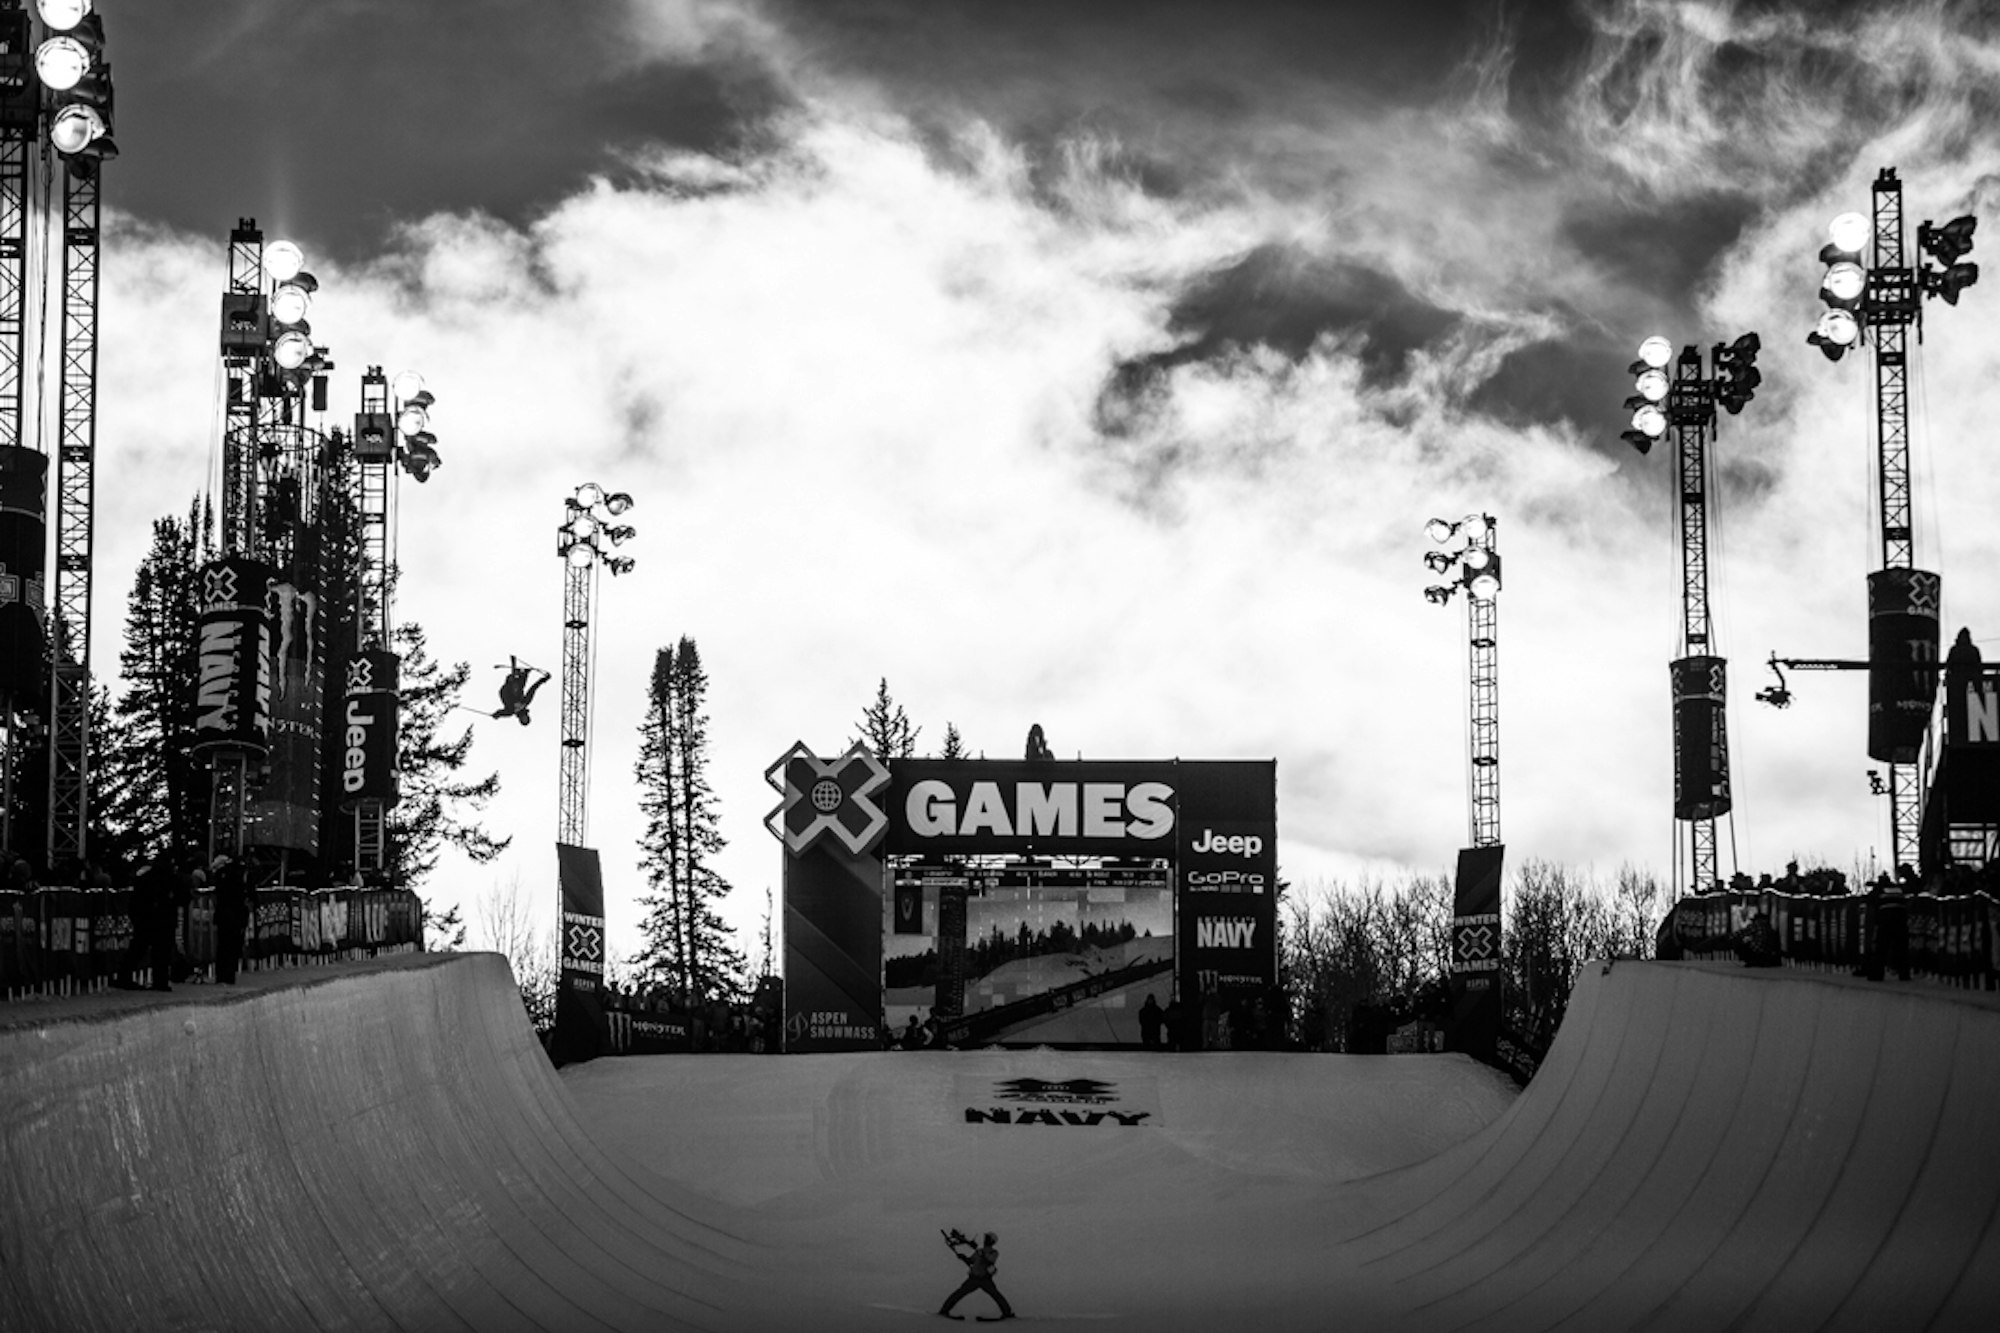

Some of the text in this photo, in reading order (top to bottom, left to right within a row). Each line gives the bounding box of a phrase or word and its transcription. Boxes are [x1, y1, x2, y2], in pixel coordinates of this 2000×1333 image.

[196, 622, 236, 732] NAVY
[343, 700, 375, 793] Jeep
[905, 779, 1177, 840] GAMES
[1192, 829, 1263, 858] Jeep
[1188, 870, 1265, 884] GoPro
[1197, 922, 1257, 948] NAVY
[1453, 958, 1500, 973] GAMES
[810, 1012, 848, 1025] ASPEN
[632, 1020, 687, 1037] MONSTER
[810, 1026, 876, 1040] SNOWMASS
[966, 1107, 1150, 1126] NAVY
